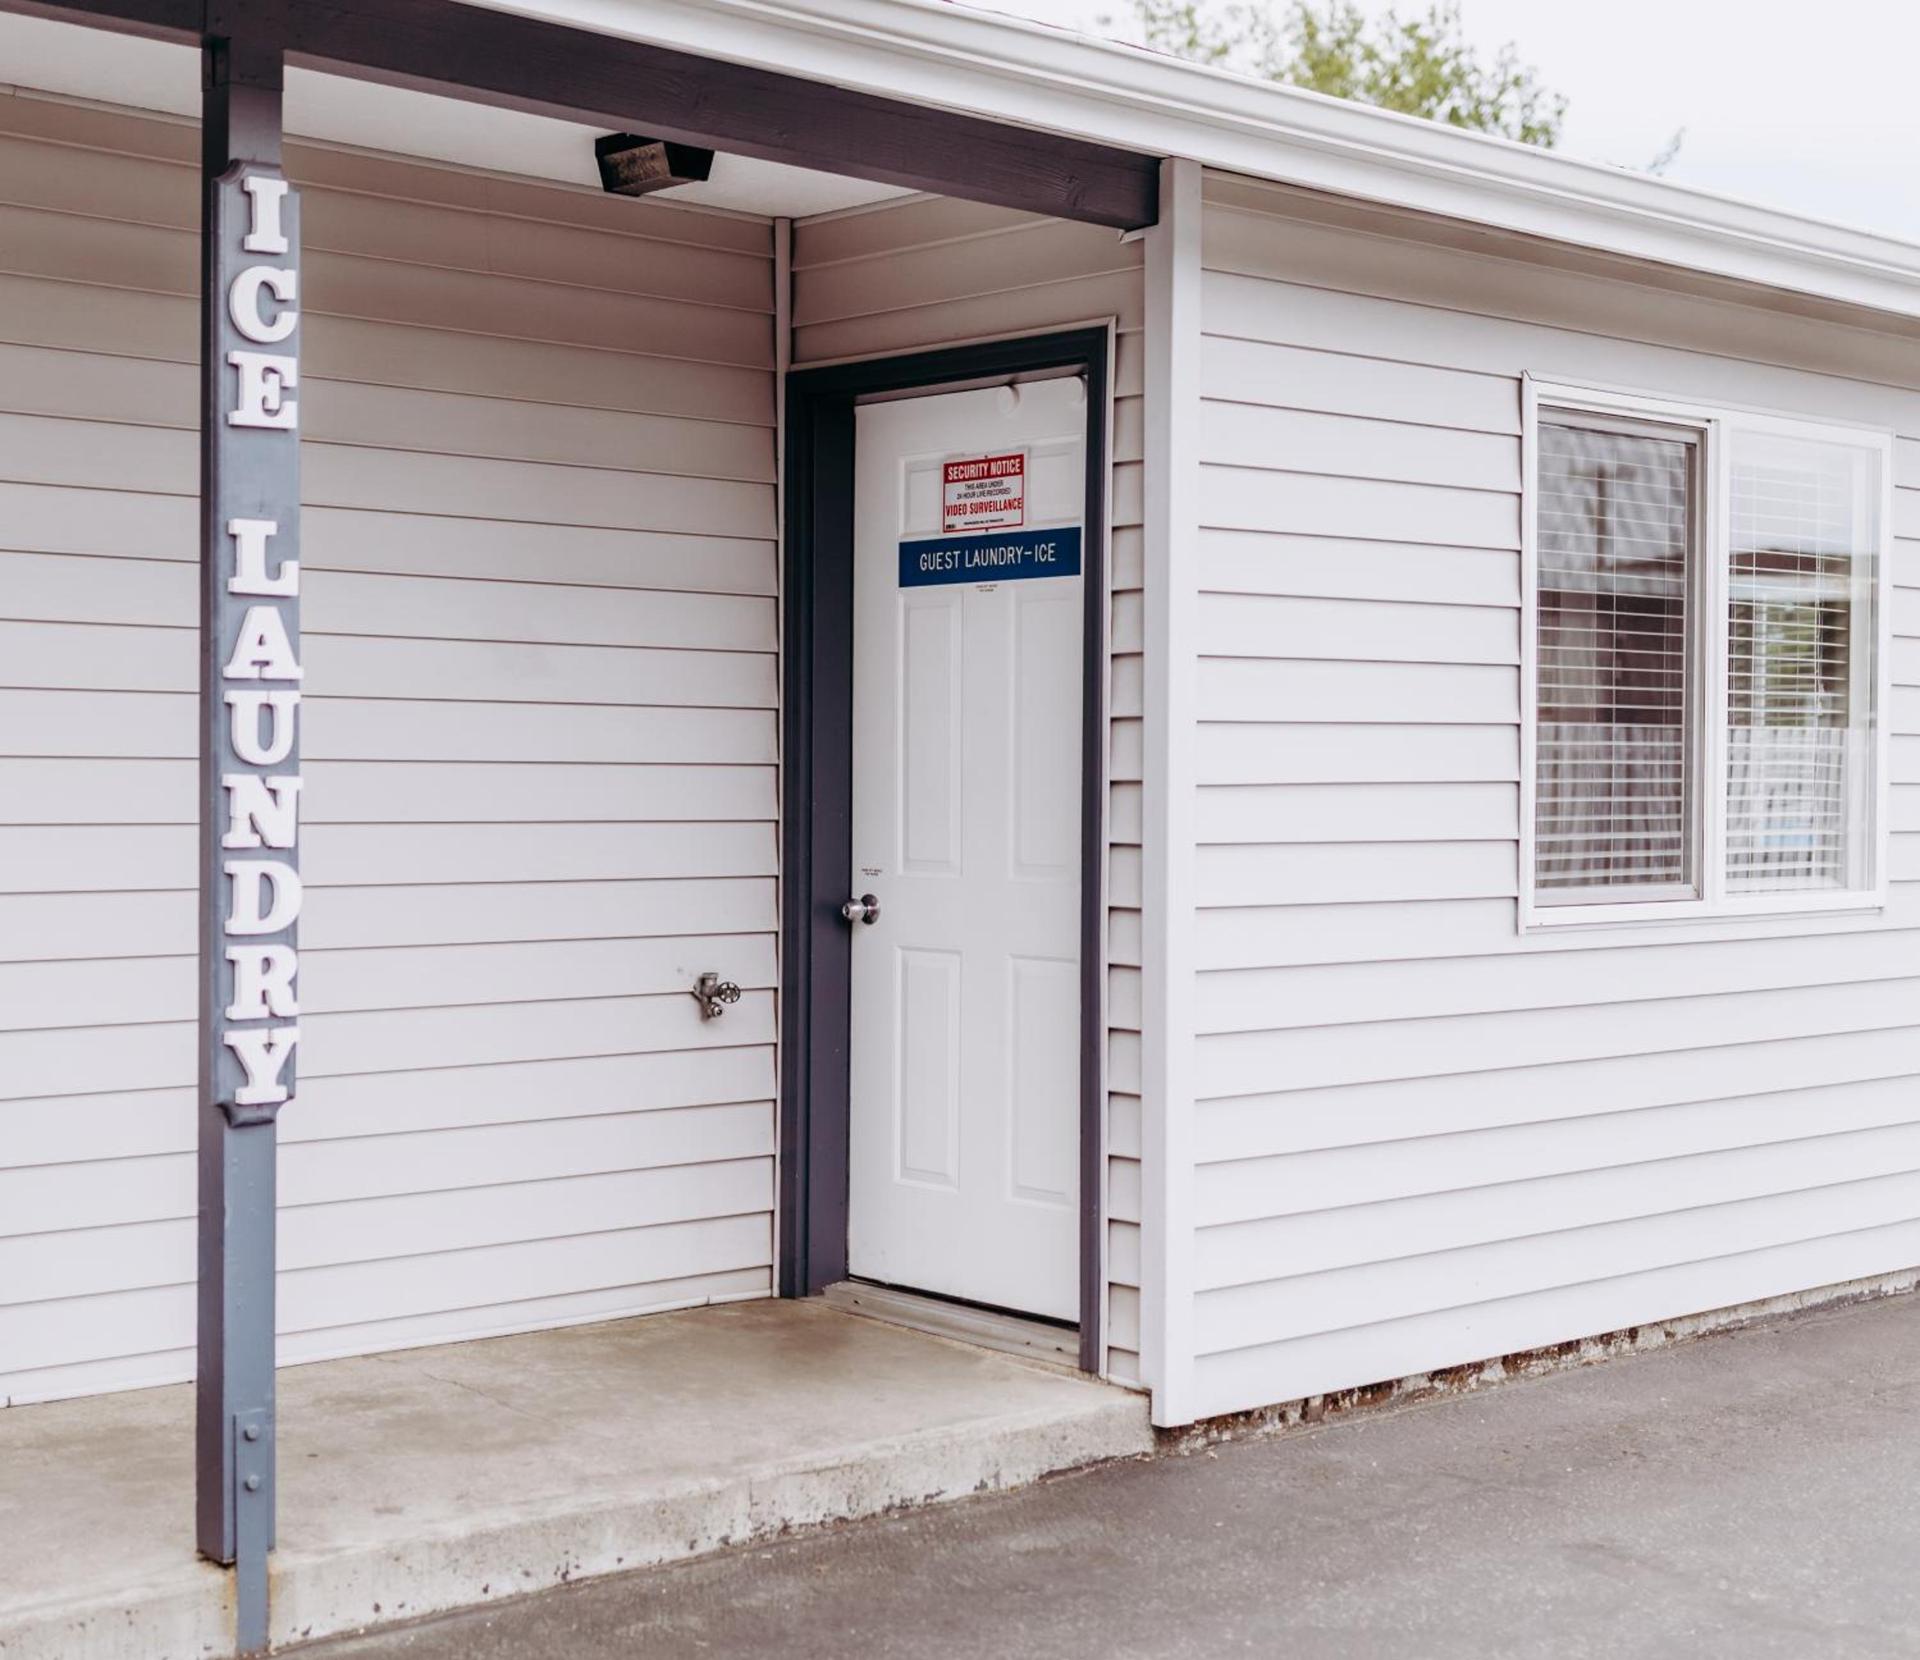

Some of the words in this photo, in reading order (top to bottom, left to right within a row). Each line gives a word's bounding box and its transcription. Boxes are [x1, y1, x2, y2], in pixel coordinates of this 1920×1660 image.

[227, 176, 299, 428] ICE
[948, 462, 989, 481] SECURITY
[990, 458, 1021, 476] NOTICE
[945, 503, 967, 517] VIDEO
[969, 497, 1023, 514] SURVEILLANCE
[919, 550, 961, 571] GUEST
[223, 518, 303, 1105] LAUNDRY
